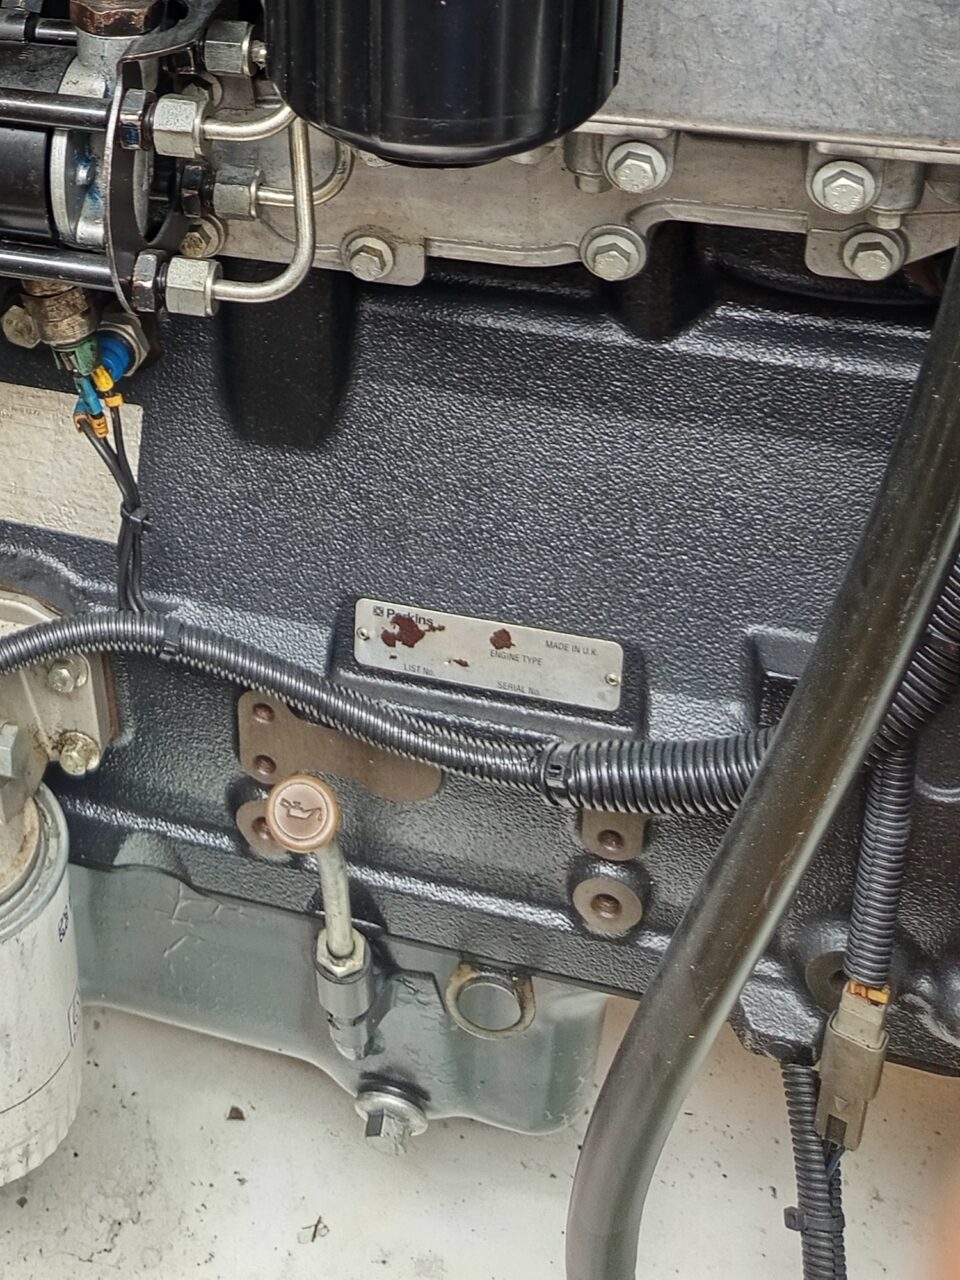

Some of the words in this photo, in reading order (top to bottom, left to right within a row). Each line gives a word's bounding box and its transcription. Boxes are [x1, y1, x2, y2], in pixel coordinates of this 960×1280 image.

[386, 608, 434, 625] Pkins
[545, 640, 569, 652] MADE
[571, 645, 581, 654] IN
[490, 649, 520, 662] ENGINE
[522, 655, 543, 666] TYPE
[497, 680, 526, 694] SERIAL
